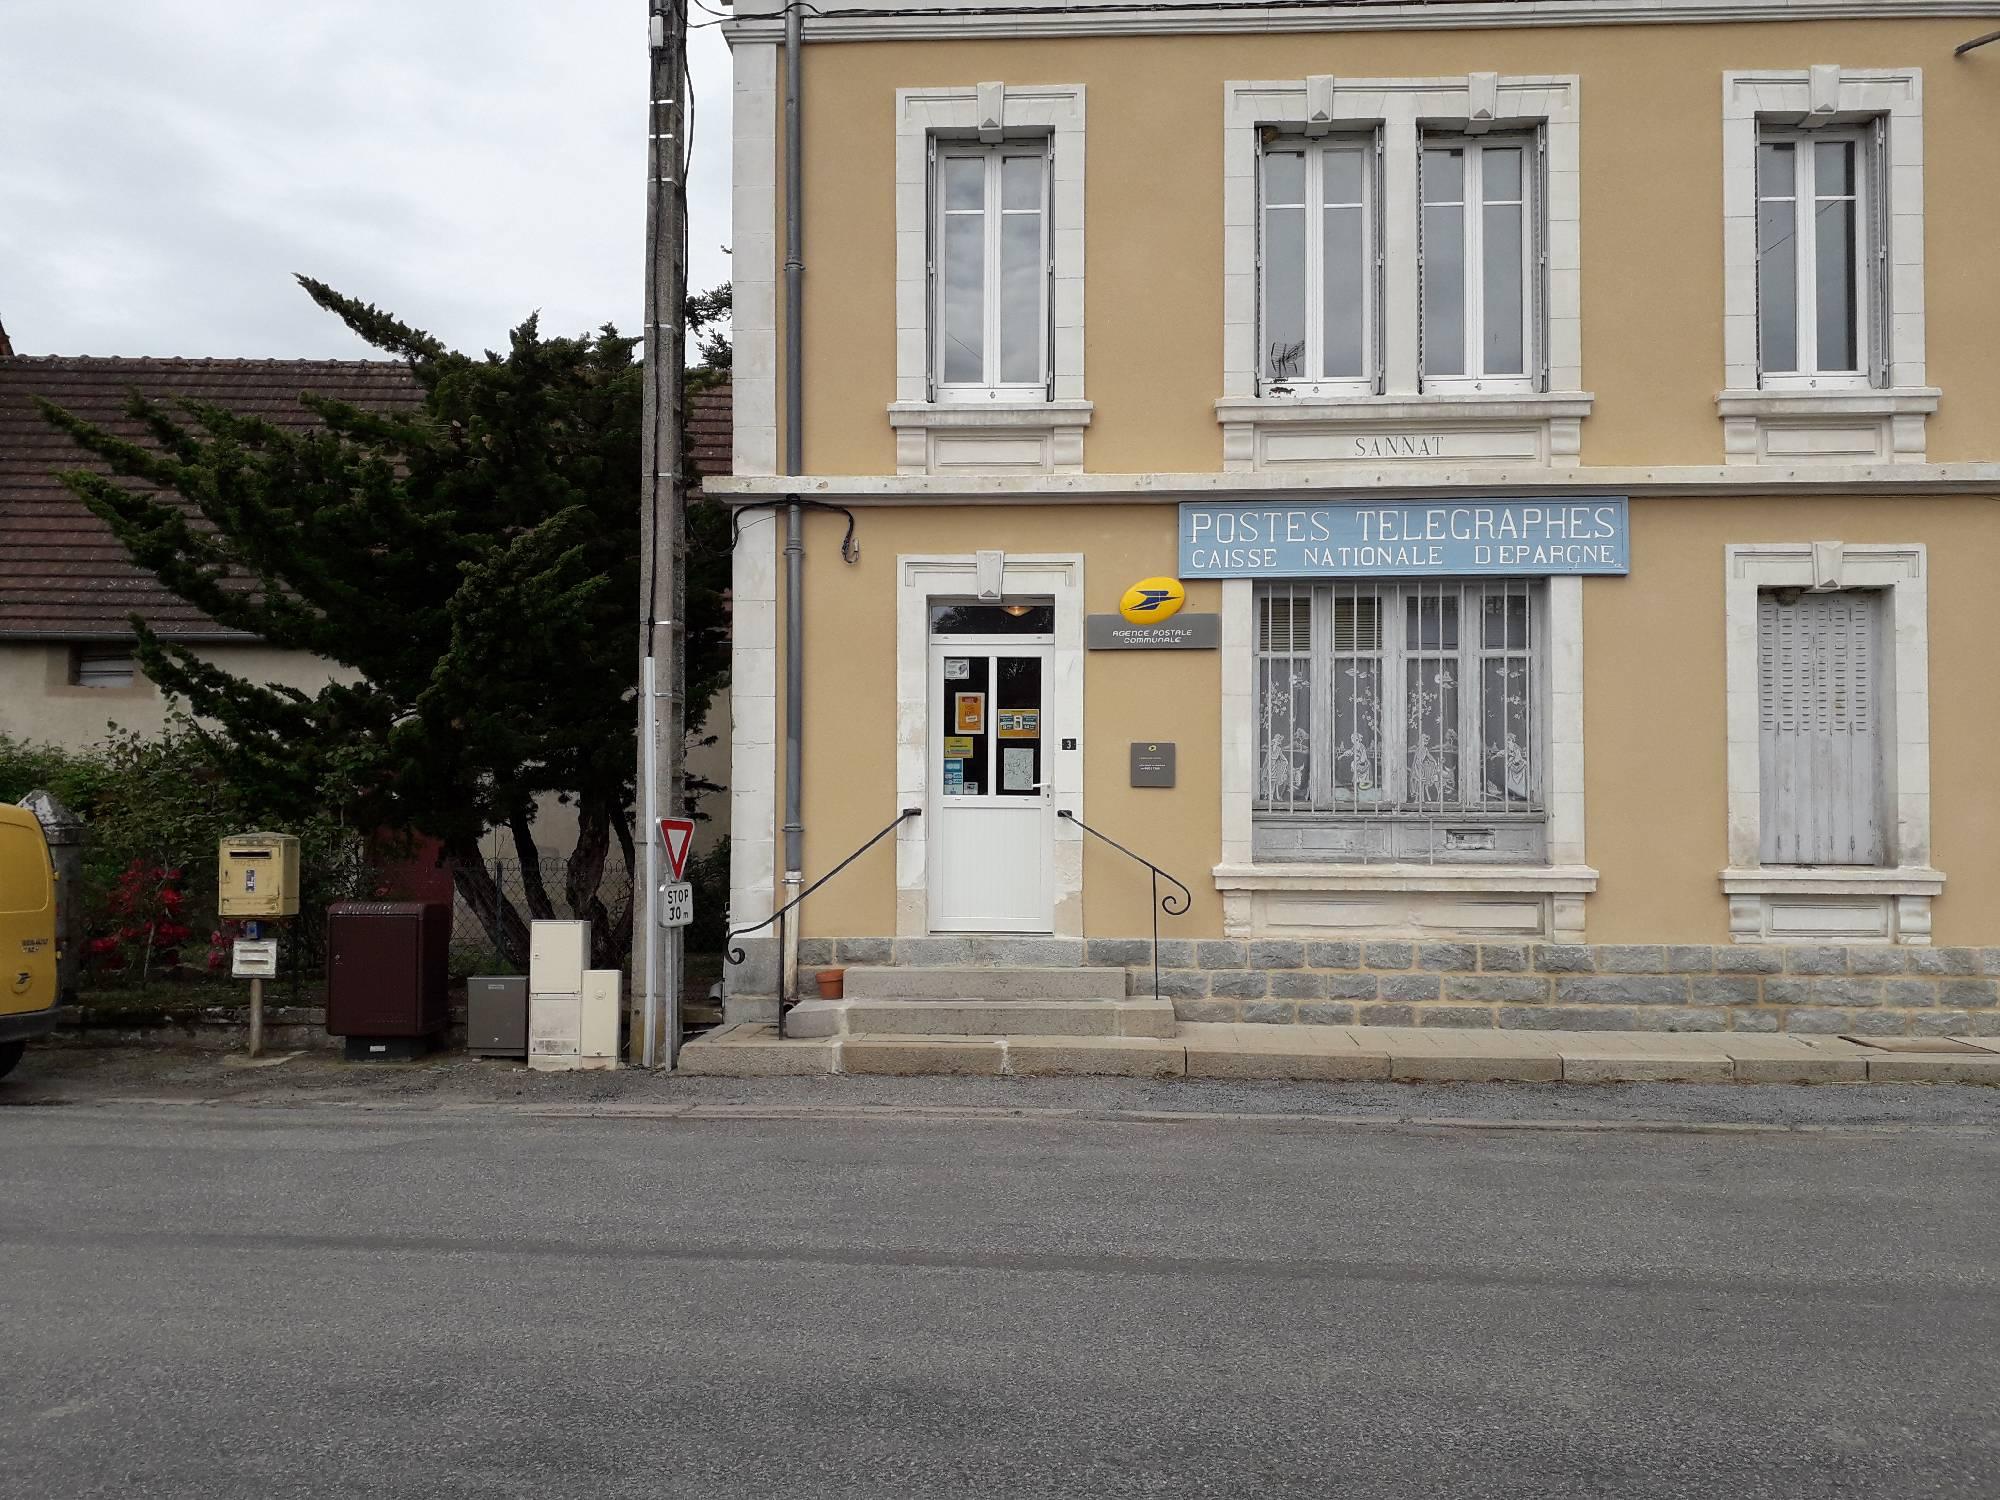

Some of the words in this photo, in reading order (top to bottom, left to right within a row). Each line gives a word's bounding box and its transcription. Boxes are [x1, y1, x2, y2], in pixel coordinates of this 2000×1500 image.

[1354, 436, 1444, 456] SANNAT
[1190, 511, 1330, 544] POSTES
[1355, 507, 1615, 542] TELEGRAPHES
[1192, 548, 1277, 569] CAISSE
[1304, 546, 1443, 567] NATIONALE
[1152, 629, 1193, 637] POSTALE
[667, 889, 688, 904] STOP
[669, 906, 681, 921] 30
[684, 911, 688, 919] m
